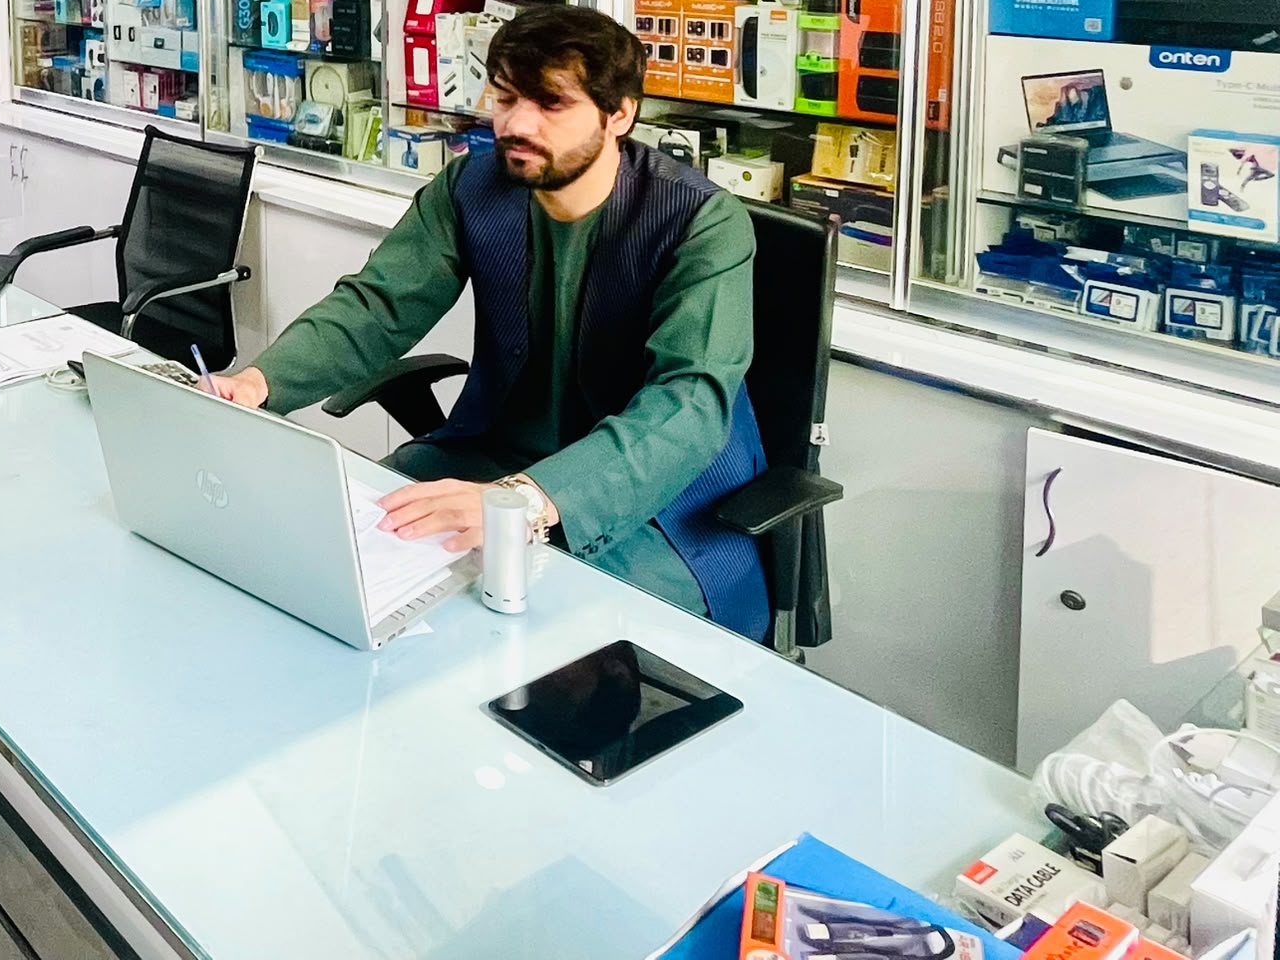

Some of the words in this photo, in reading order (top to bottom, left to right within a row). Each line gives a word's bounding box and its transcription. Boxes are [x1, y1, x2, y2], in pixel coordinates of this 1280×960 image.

[1159, 50, 1220, 67] onten
[199, 469, 227, 507] hp
[1004, 882, 1033, 907] DATA
[1028, 862, 1062, 889] CABLE
